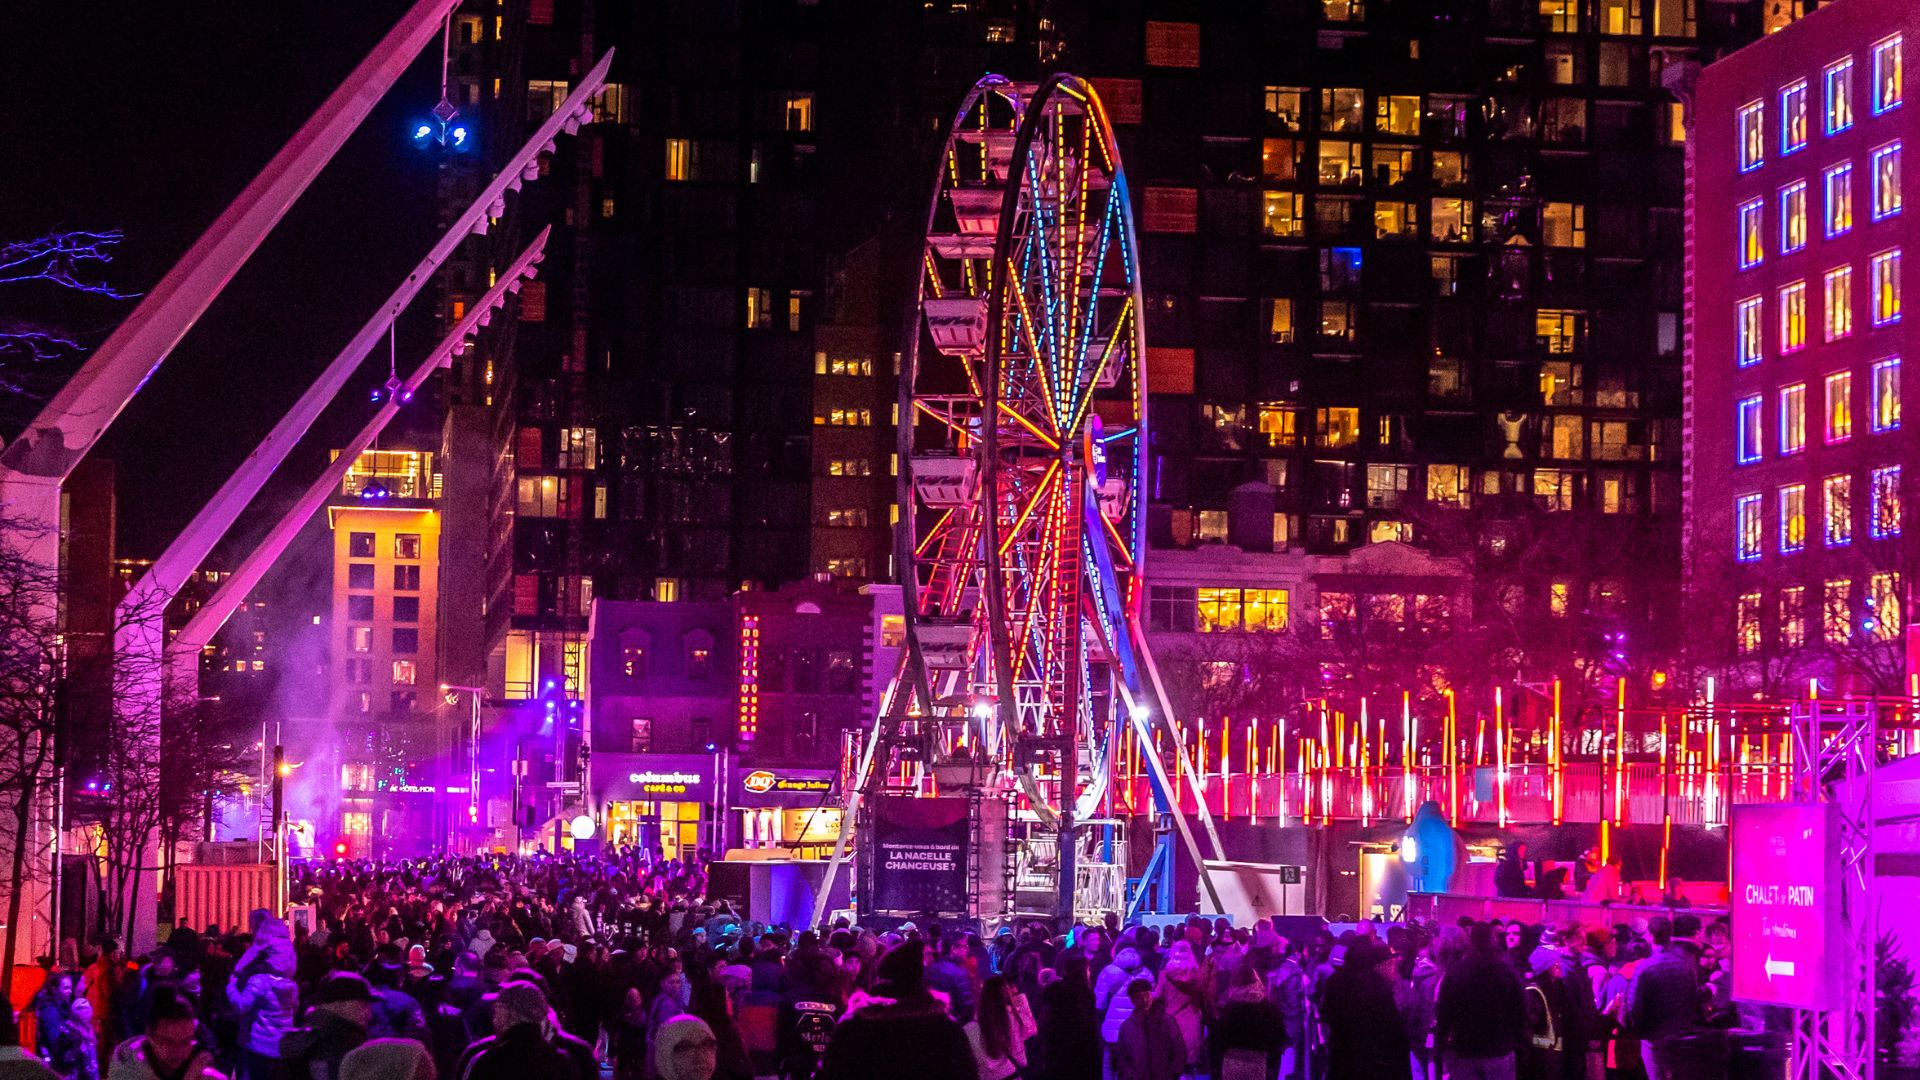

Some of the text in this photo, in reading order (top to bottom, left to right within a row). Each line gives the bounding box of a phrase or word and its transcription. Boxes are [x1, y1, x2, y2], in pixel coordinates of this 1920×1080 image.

[629, 771, 700, 784] columbus
[750, 775, 771, 788] DQ
[777, 779, 830, 790] Orange Julius
[890, 851, 952, 861] LA NACELLE
[885, 861, 950, 871] CHANCEUSE
[1745, 883, 1779, 905] CHALET
[1788, 885, 1814, 907] PATIN
